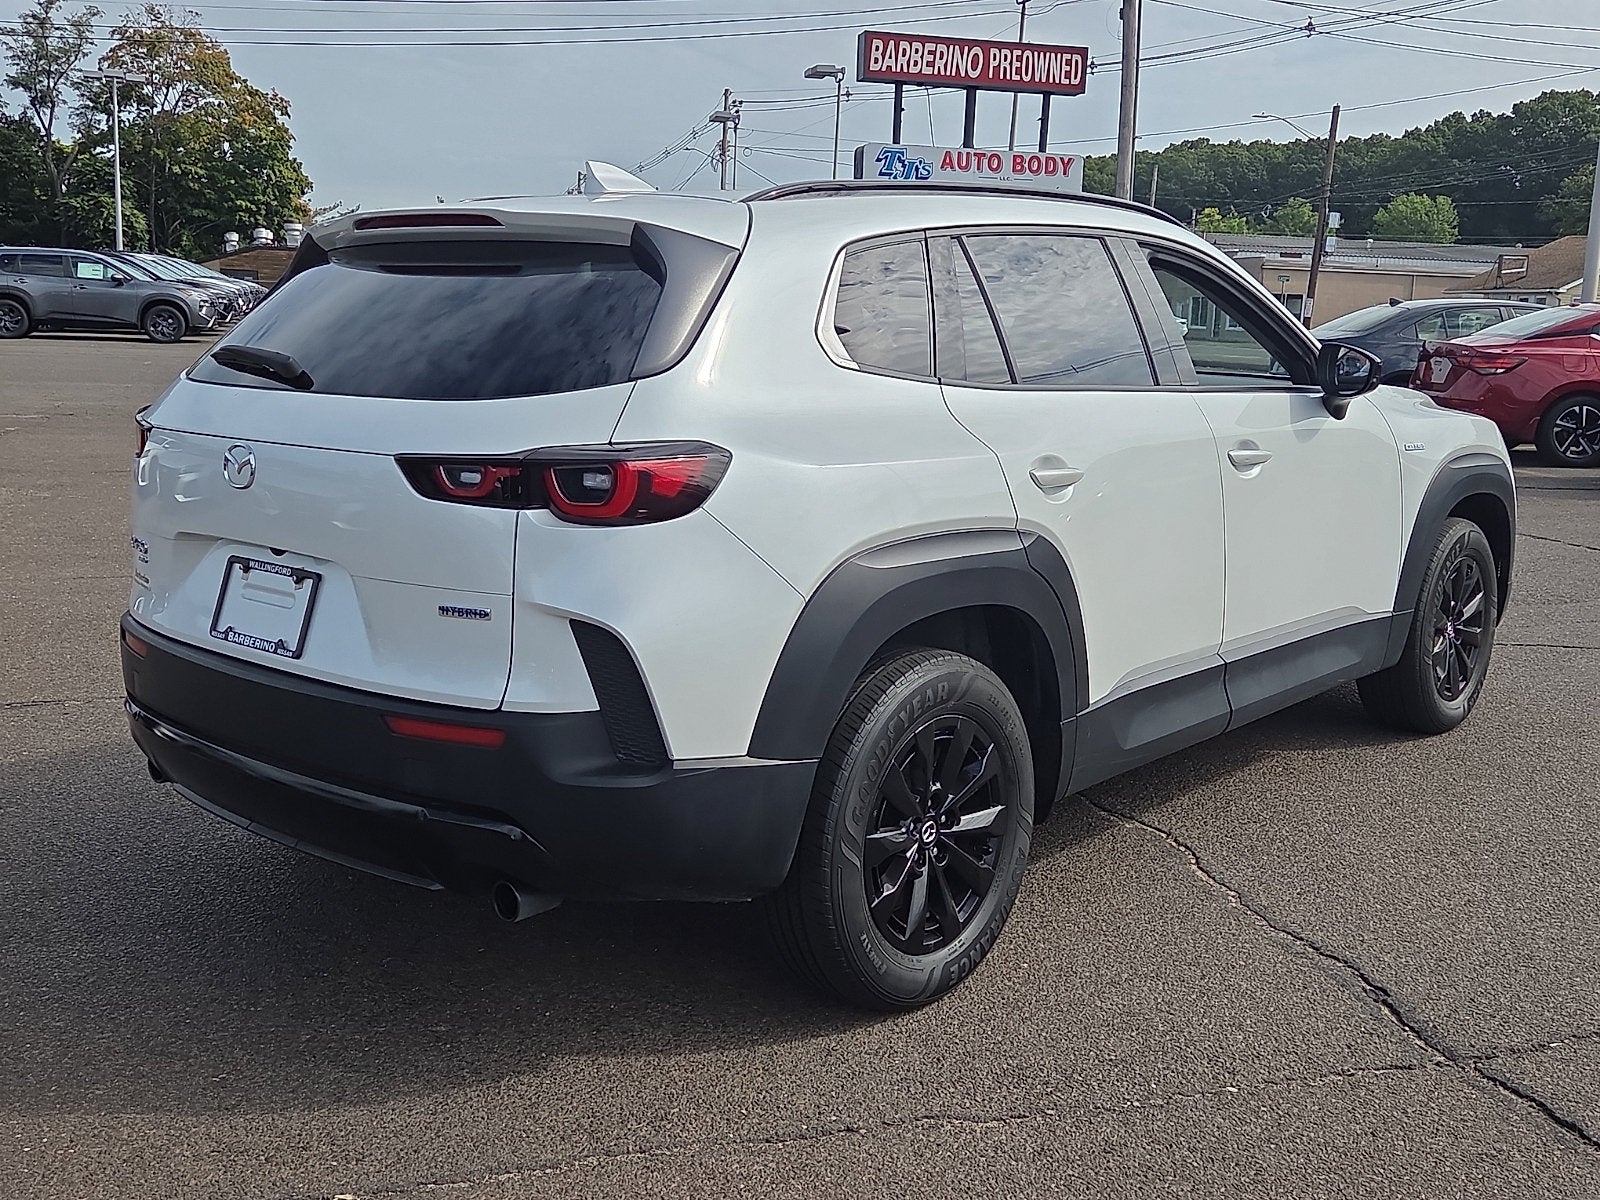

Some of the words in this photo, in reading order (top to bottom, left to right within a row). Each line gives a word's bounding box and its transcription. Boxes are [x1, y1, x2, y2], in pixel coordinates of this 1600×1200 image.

[869, 39, 984, 79] BARBERINO
[989, 48, 1082, 85] PREOWNED
[940, 150, 1003, 173] AUTO
[1012, 154, 1075, 177] BODY
[248, 560, 292, 576] WALLINGFORD
[438, 605, 490, 619] HYBRID
[228, 631, 275, 652] BARBERINO
